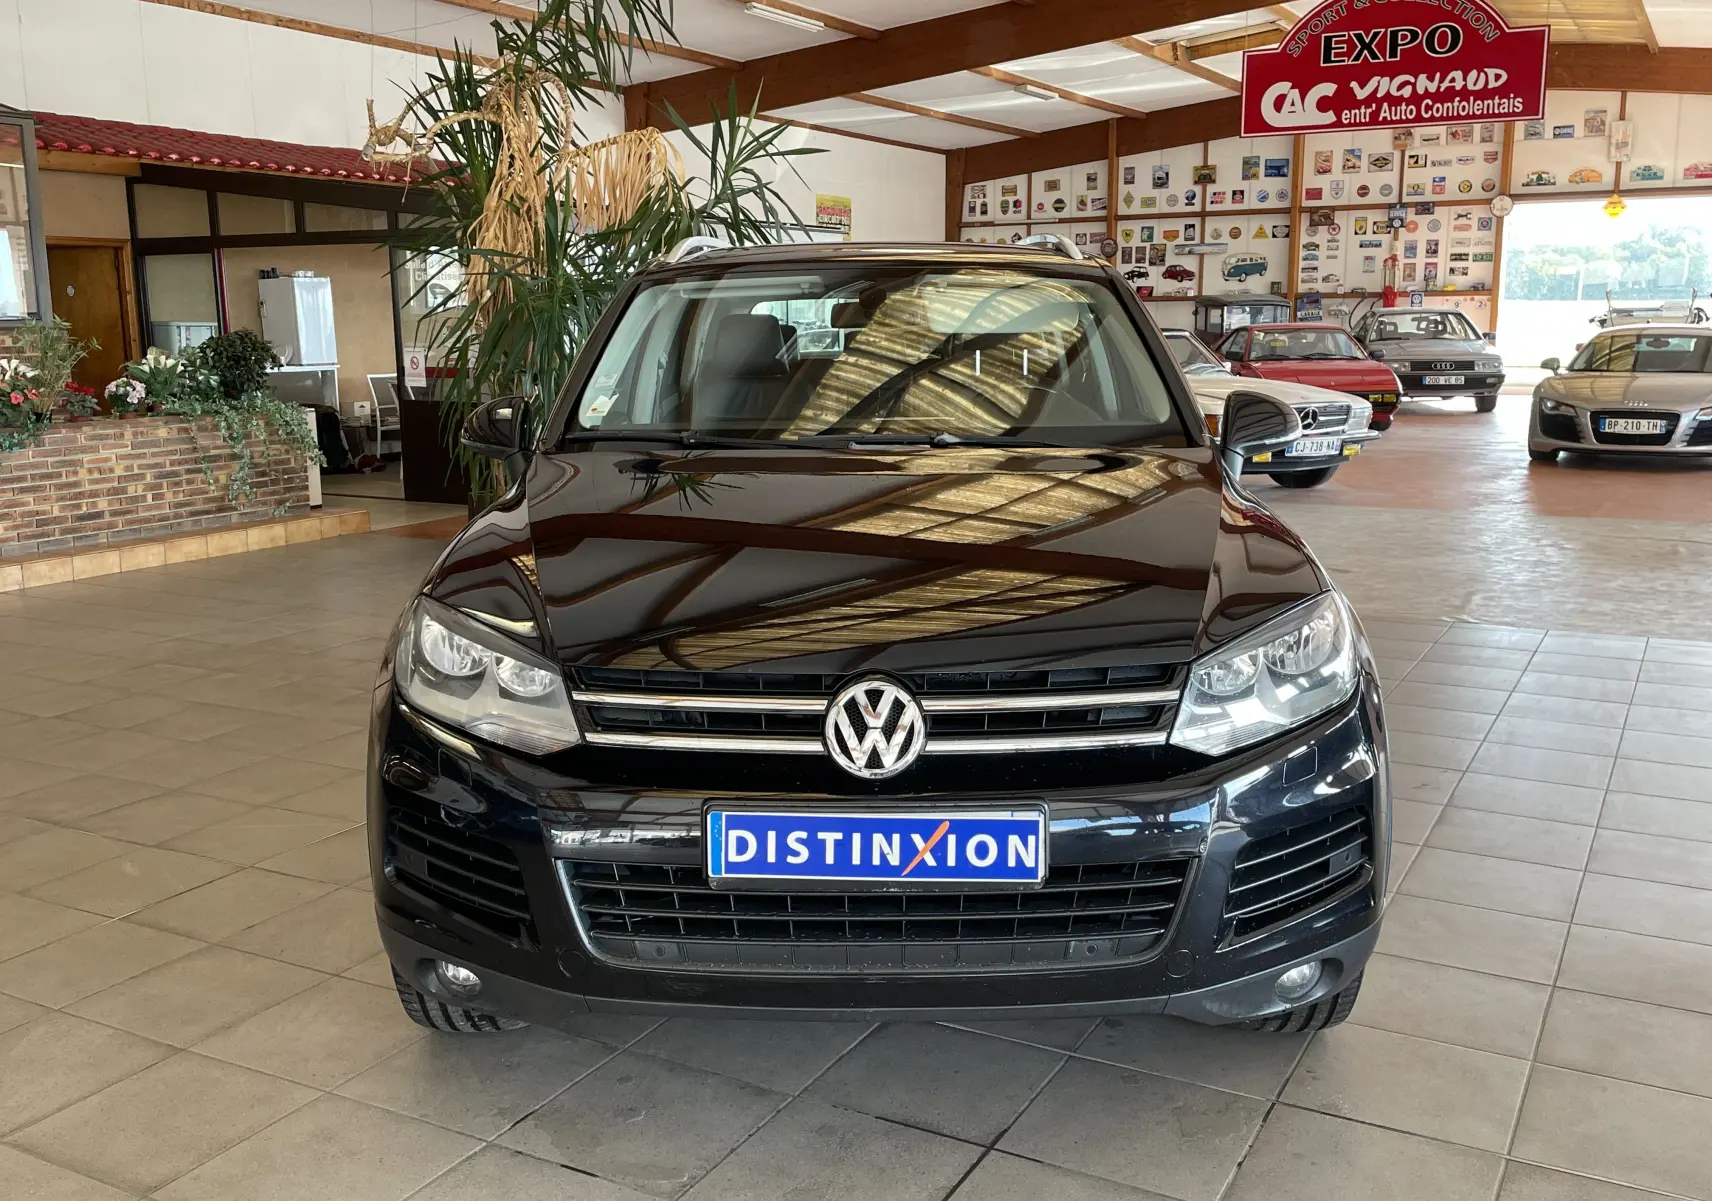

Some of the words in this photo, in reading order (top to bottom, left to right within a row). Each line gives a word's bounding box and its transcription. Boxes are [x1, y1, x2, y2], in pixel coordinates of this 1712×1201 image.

[1286, 1, 1347, 57] SPORT
[1320, 22, 1463, 67] EXPO
[1350, 67, 1508, 100] VIGNAUD
[1341, 103, 1376, 124] entr'
[1379, 101, 1416, 121] Auto
[1420, 94, 1524, 118] Confolentais
[1427, 376, 1440, 384] 200
[1607, 420, 1658, 431] BP-210-TH
[1294, 440, 1335, 453] CJ-738-NA
[727, 822, 1036, 876] DISTINXION
